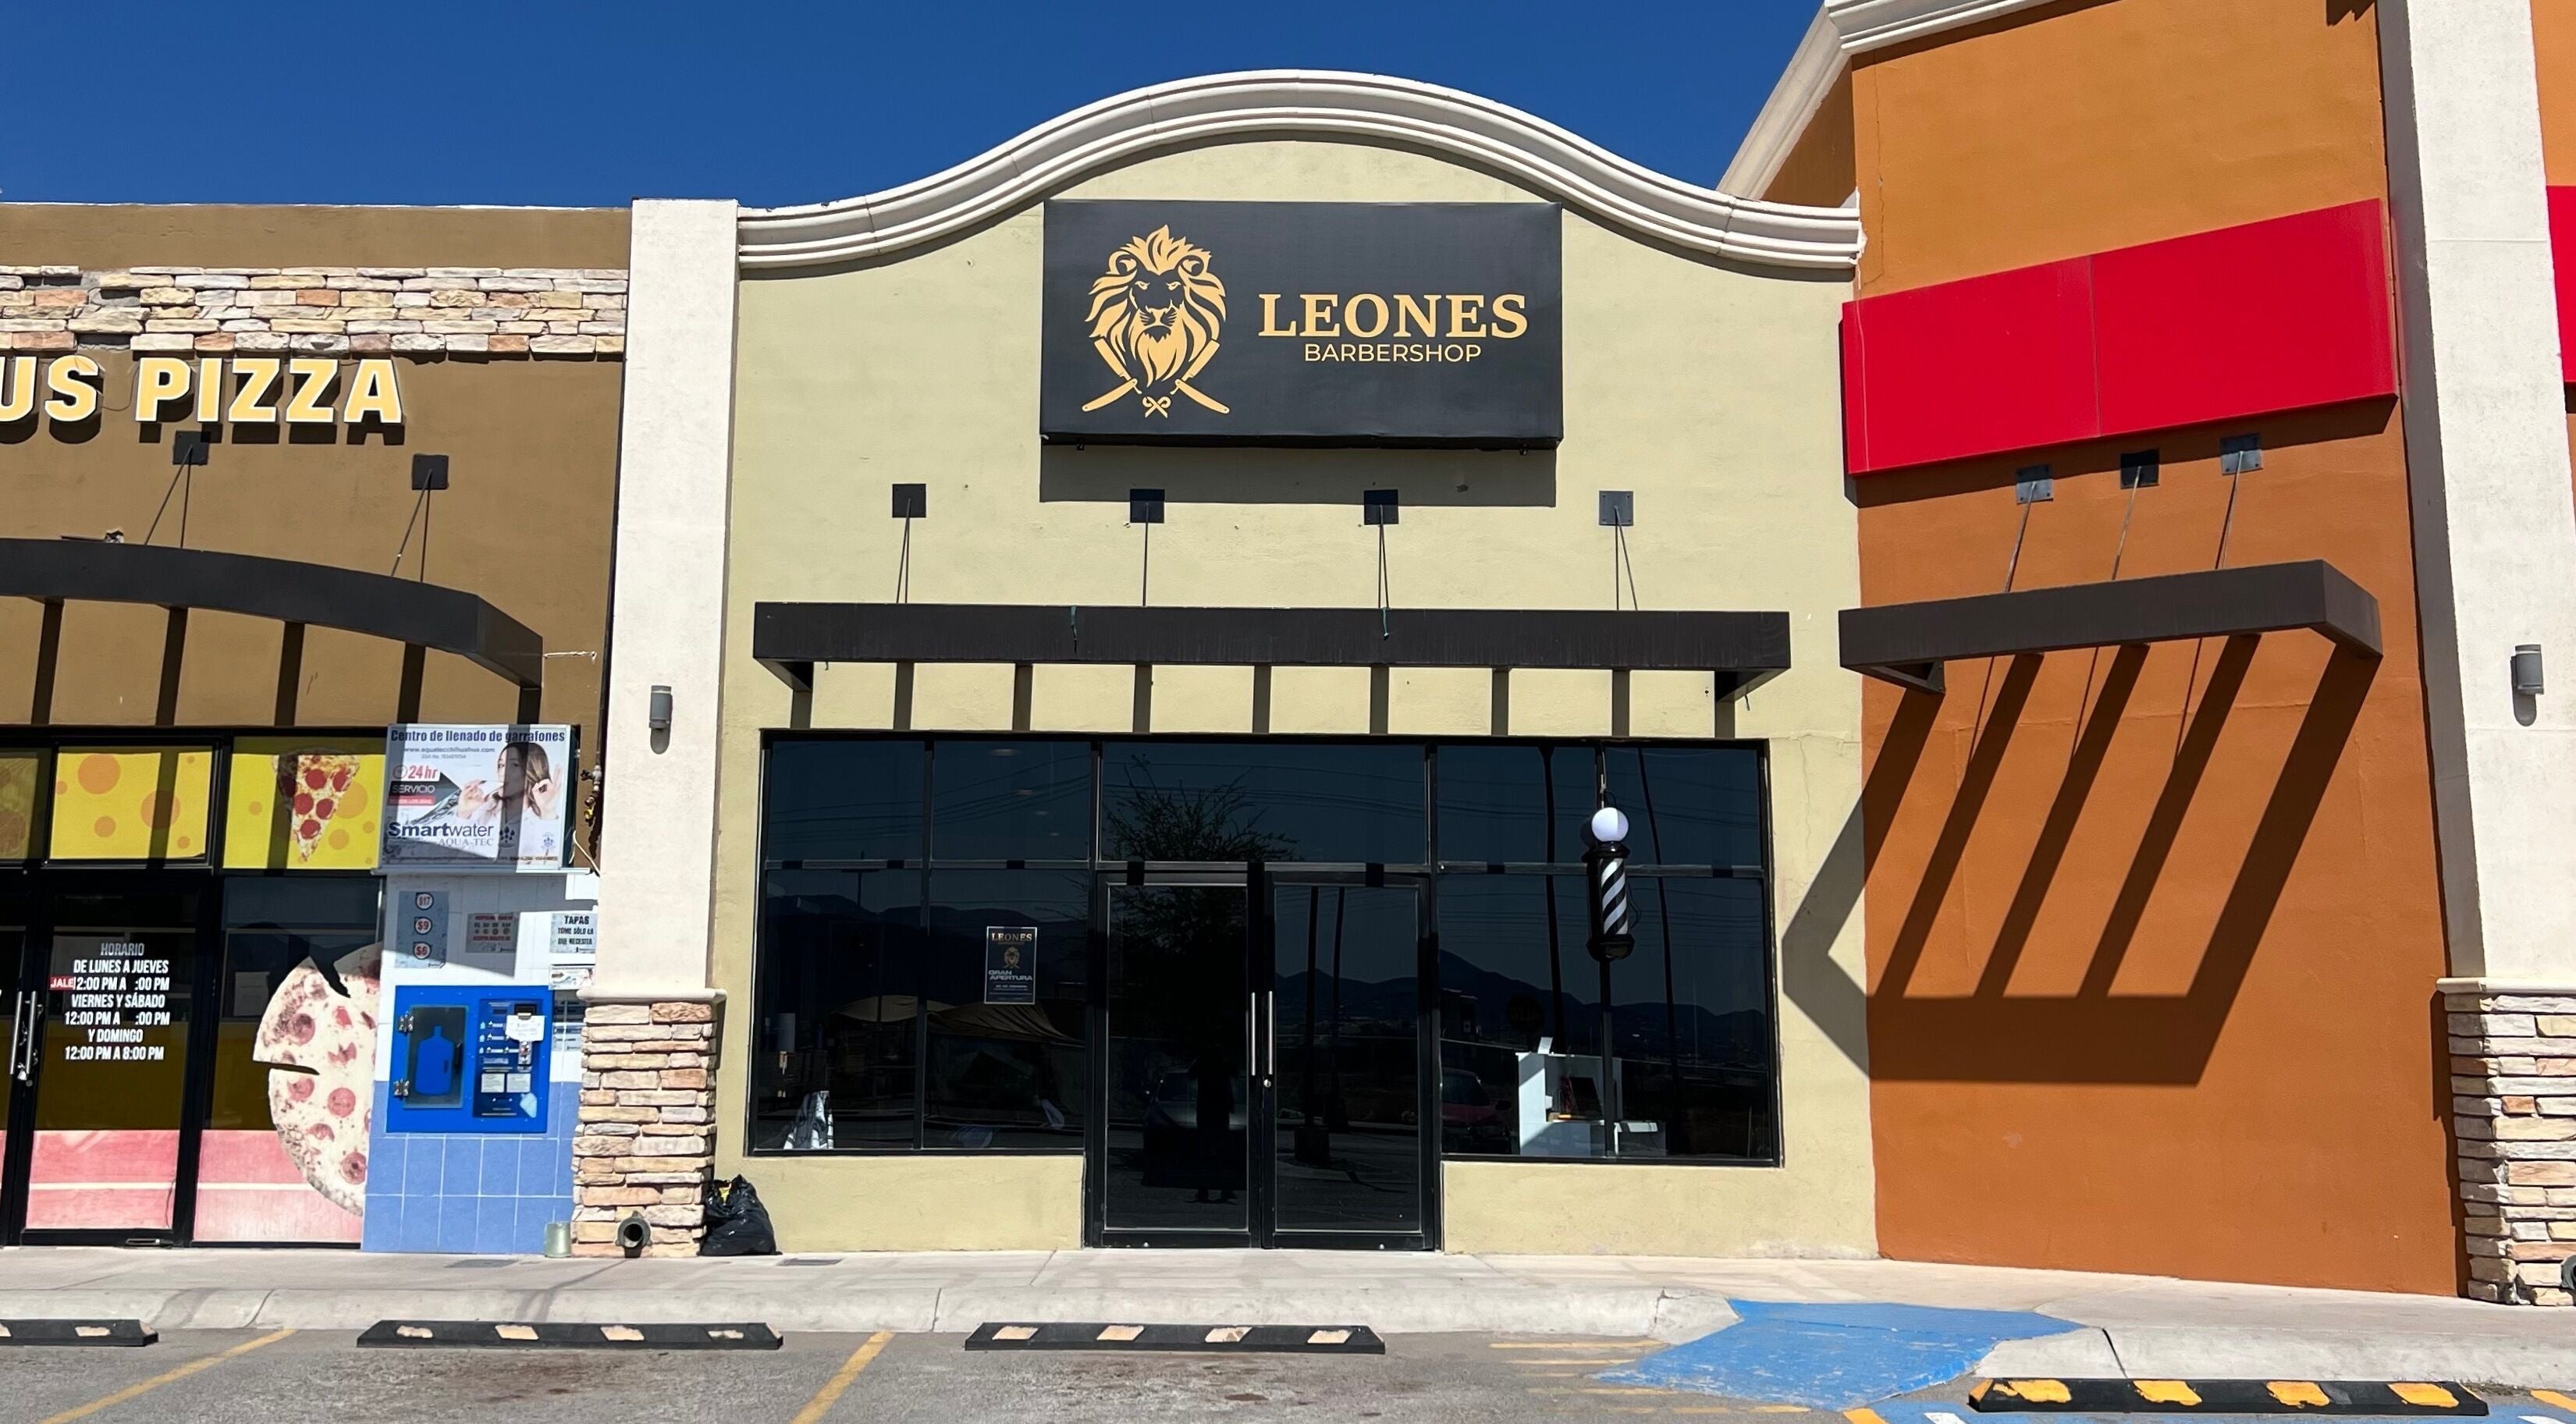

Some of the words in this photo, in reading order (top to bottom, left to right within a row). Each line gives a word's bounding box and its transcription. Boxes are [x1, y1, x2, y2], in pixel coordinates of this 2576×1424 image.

[1258, 293, 1528, 339] LEONES
[1305, 343, 1481, 362] BARBERSHOP
[0, 355, 99, 422] US
[135, 357, 403, 424] PIZZA
[391, 730, 427, 741] Centro
[430, 730, 443, 741] de
[446, 730, 486, 742] llenado
[489, 730, 503, 742] de
[505, 730, 565, 744] garrafones
[393, 784, 435, 794] SERVICIO
[388, 822, 495, 837] Smartwater
[438, 837, 495, 847] AQUA-TEC
[417, 921, 429, 931] $9
[564, 915, 590, 925] TAPAS
[991, 932, 1032, 942] LEONES
[100, 943, 145, 956] HORARIO
[73, 960, 87, 974] DE
[89, 960, 121, 974] LUNES
[123, 960, 130, 974] A
[131, 960, 169, 974] JUEVES
[50, 978, 74, 989] JALE
[101, 977, 118, 991] PM
[119, 977, 126, 991] A
[154, 977, 170, 991] PM
[71, 994, 114, 1008] VIERNES
[116, 994, 124, 1008] Y
[124, 992, 165, 1008] SÁBADO
[65, 1011, 94, 1025] 12:00
[95, 1011, 112, 1025] PM
[112, 1011, 120, 1025] A
[154, 1011, 170, 1025] PM
[87, 1028, 95, 1042] Y
[97, 1028, 144, 1042] DOMINGO
[65, 1046, 94, 1060] 12:00
[95, 1046, 112, 1060] PM
[112, 1046, 121, 1060] A
[123, 1046, 147, 1060] 8:00
[147, 1046, 165, 1060] PM
